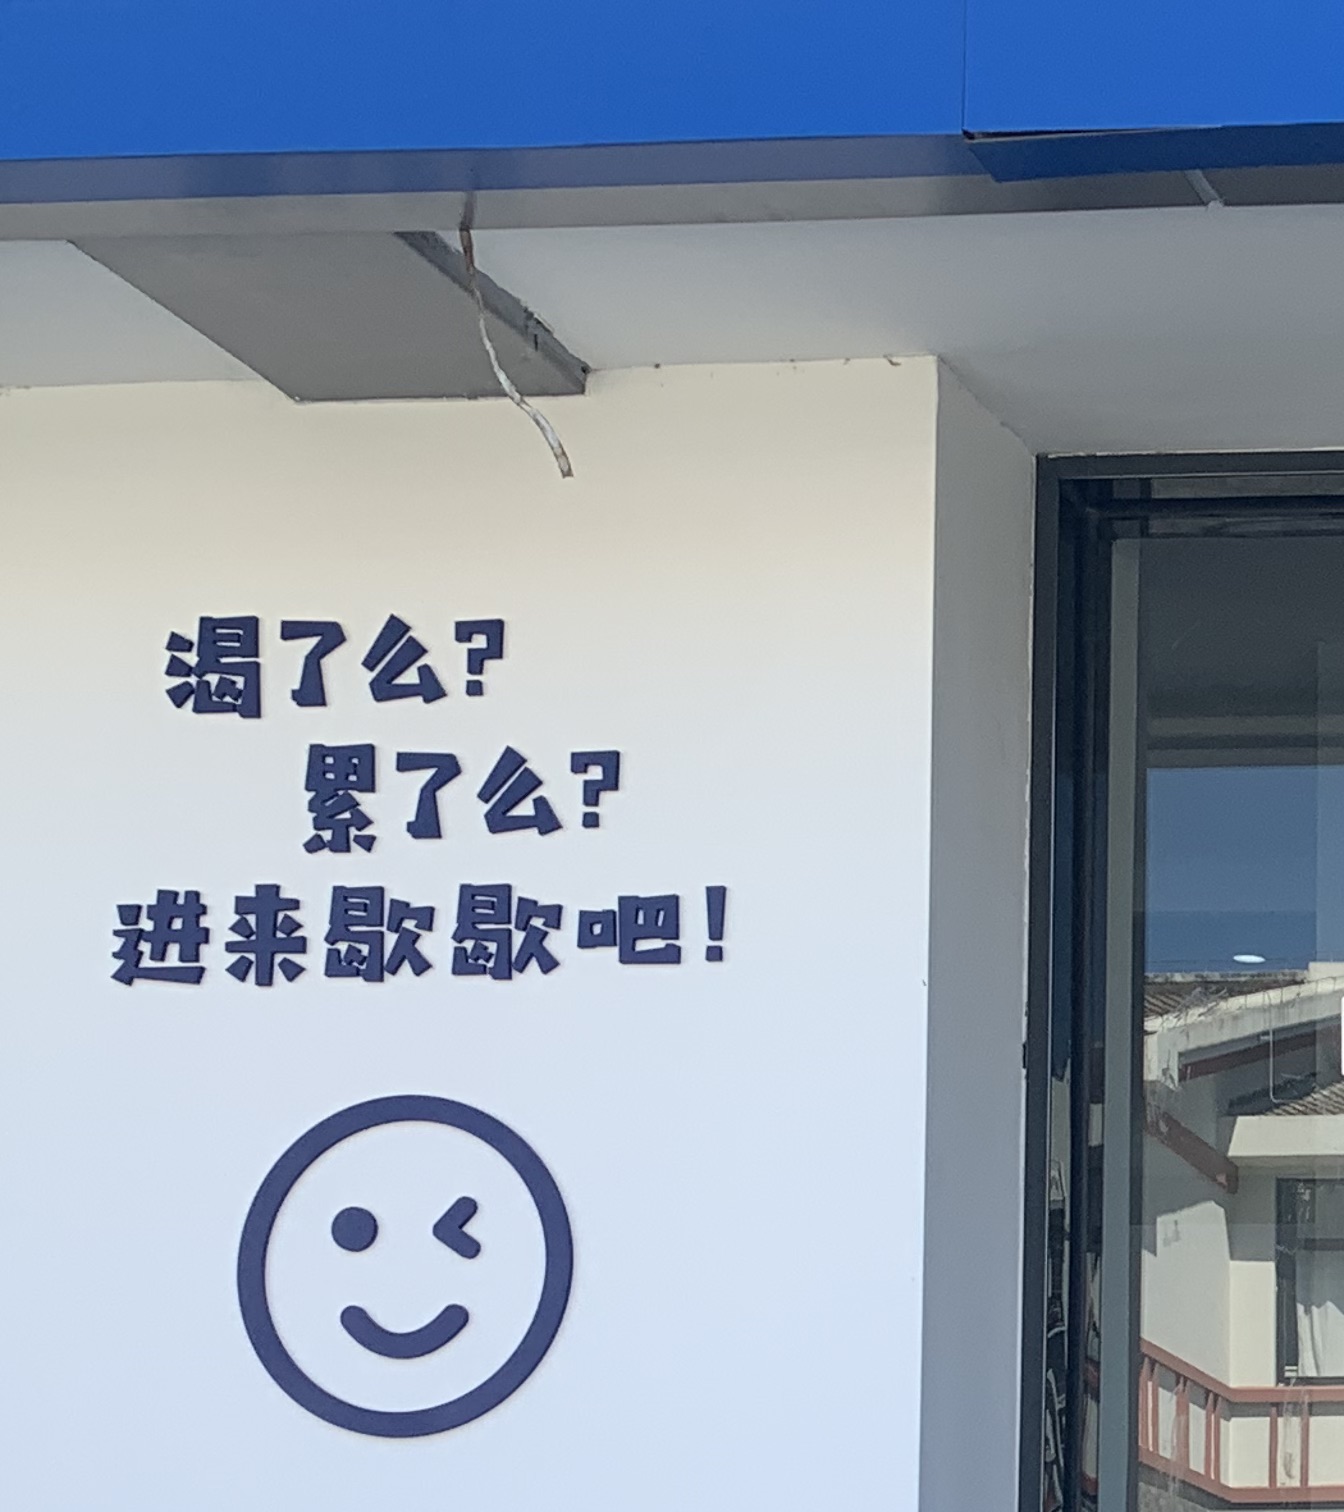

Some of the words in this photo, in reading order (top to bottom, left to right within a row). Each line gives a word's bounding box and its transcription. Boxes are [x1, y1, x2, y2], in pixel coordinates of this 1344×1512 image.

[165, 614, 505, 718] 渴了么?
[303, 743, 620, 852] 累了么?
[112, 884, 727, 985] 进来歇歇吧!
